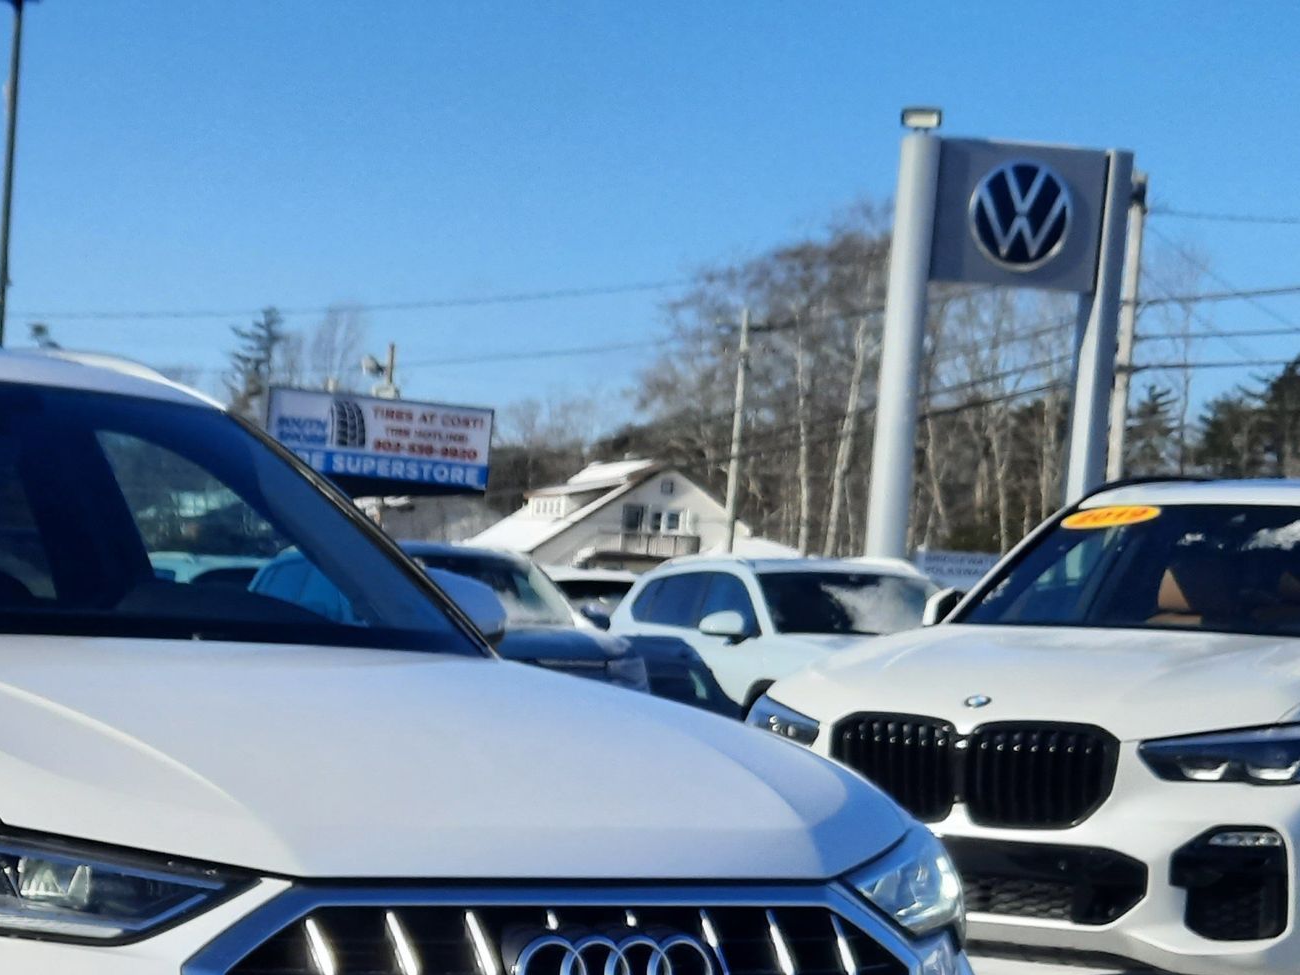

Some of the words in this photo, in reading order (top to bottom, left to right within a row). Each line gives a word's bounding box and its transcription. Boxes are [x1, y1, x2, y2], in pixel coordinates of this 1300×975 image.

[277, 416, 327, 431] SOUTH
[373, 405, 413, 421] TIRES
[419, 411, 437, 425] AT
[441, 414, 484, 429] COST!
[331, 453, 479, 487] SUPERSTORE
